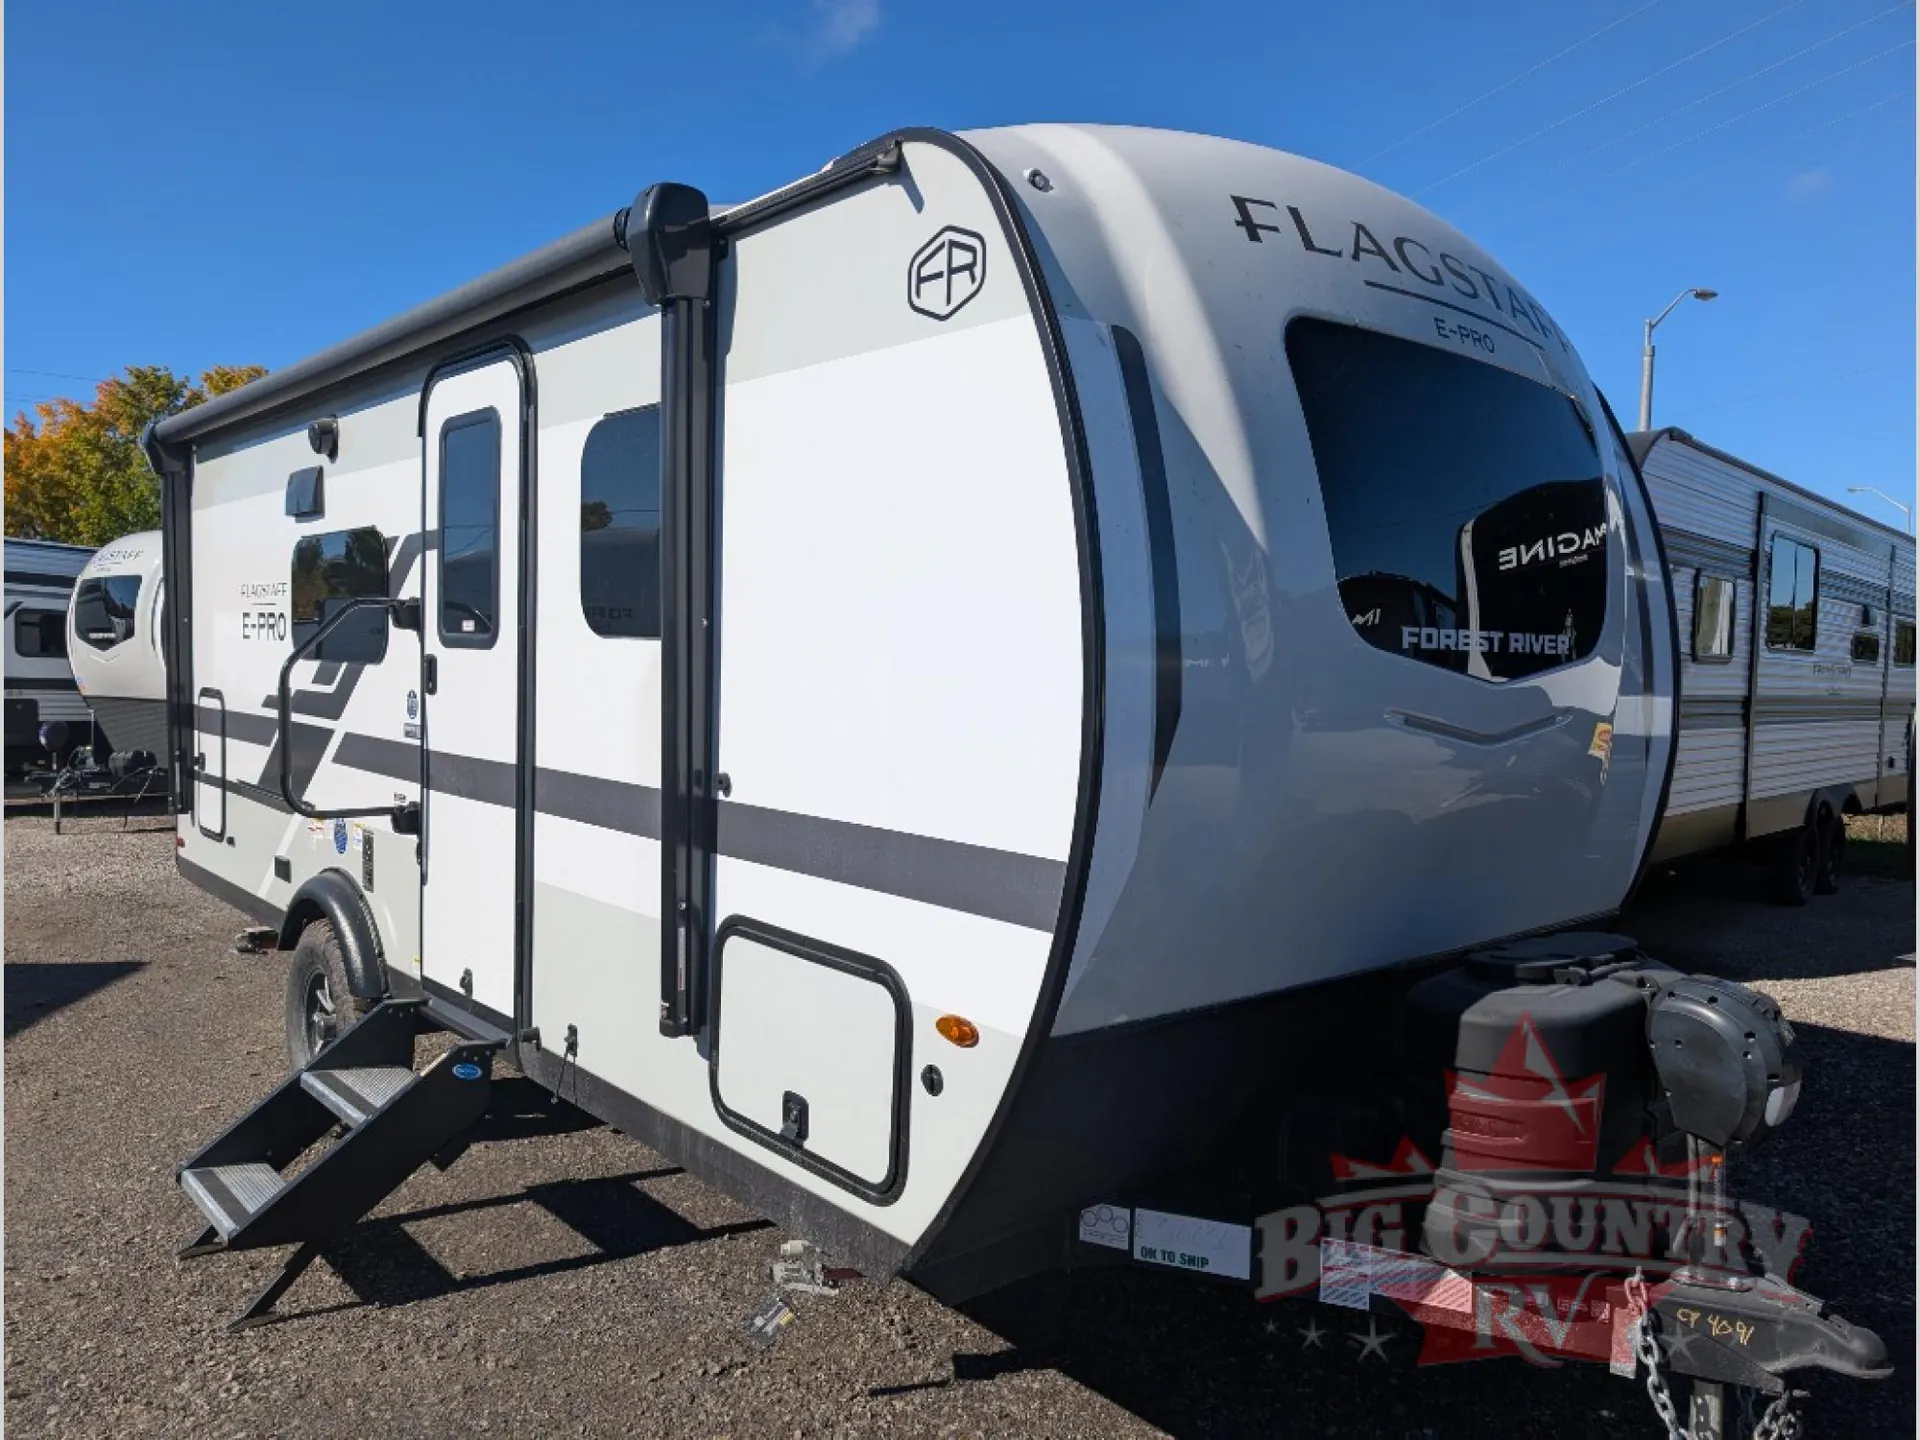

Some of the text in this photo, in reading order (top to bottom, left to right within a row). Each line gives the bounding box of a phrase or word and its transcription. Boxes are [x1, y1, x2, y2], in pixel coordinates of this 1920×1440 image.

[1434, 316, 1496, 354] E-PRO
[242, 611, 287, 641] E-PRO
[1402, 626, 1570, 655] FOREST RIVER
[1140, 1246, 1209, 1269] OK TO SHIP
